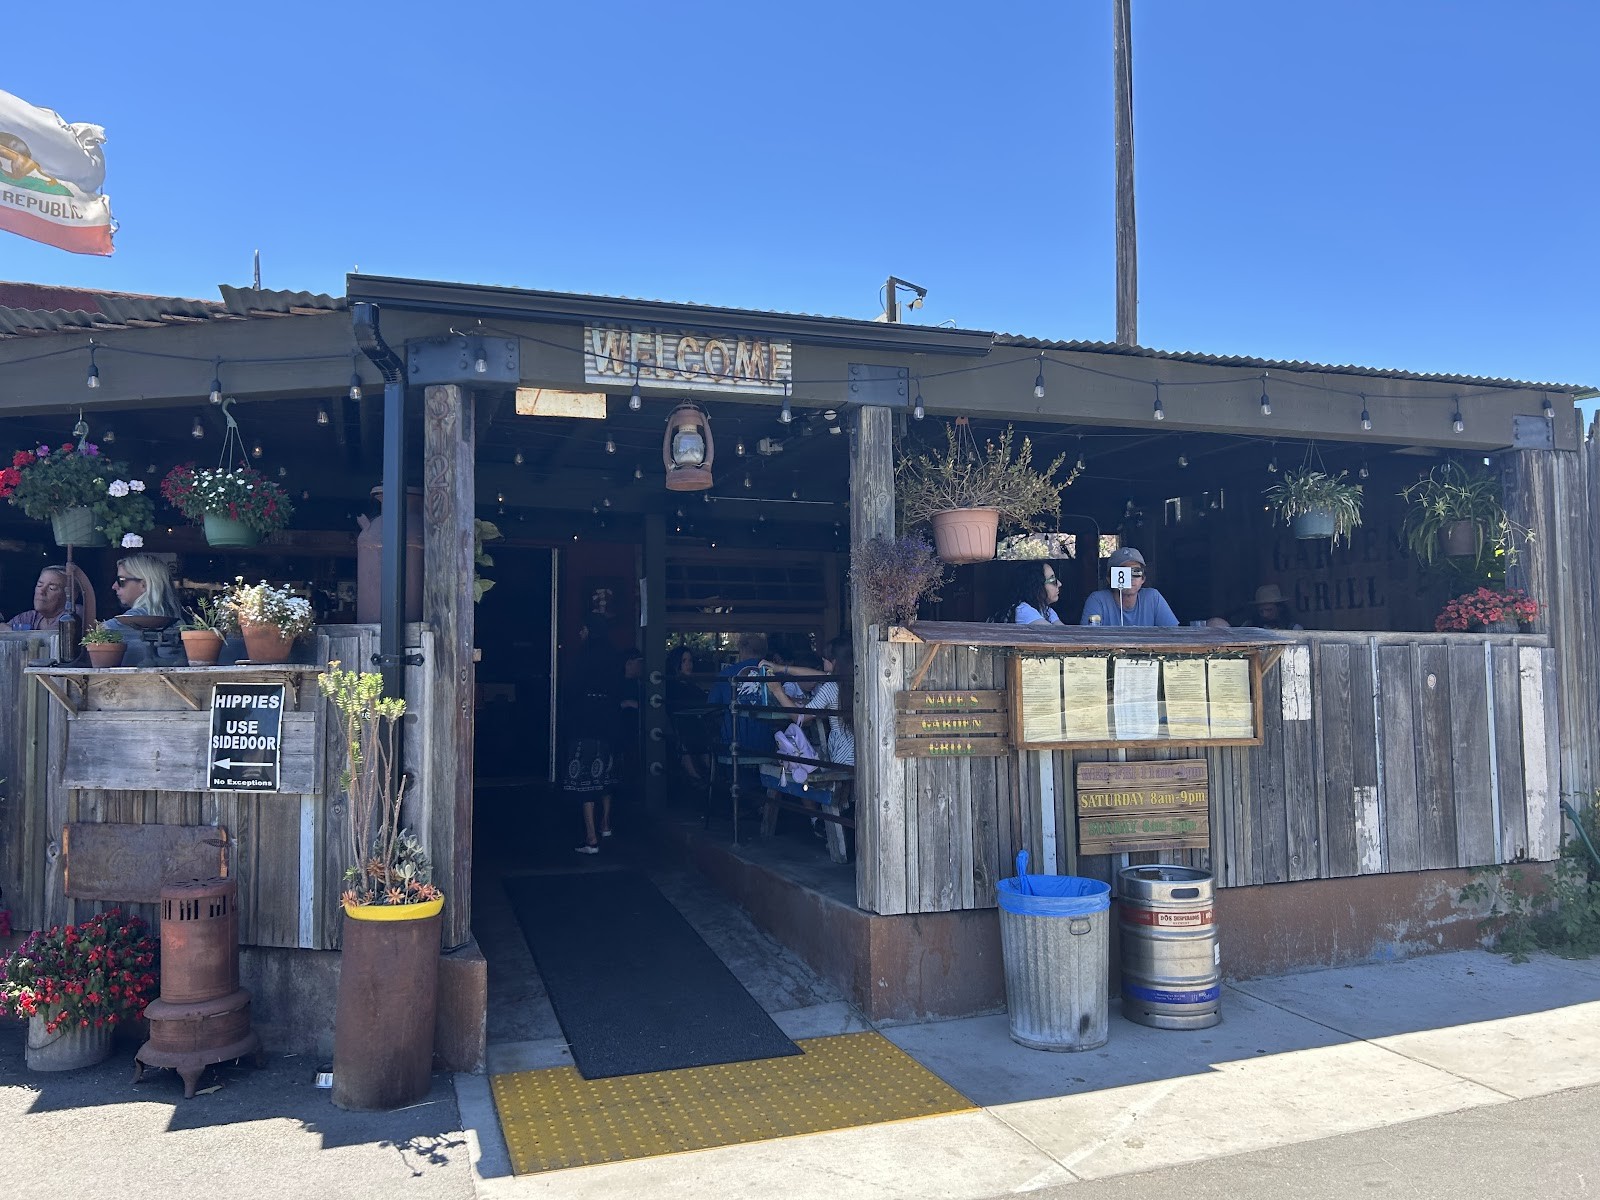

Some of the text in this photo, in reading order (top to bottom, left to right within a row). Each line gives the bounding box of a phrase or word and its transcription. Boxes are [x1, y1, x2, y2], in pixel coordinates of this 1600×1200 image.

[592, 328, 790, 384] WELCOME
[1117, 571, 1125, 584] 8
[1295, 576, 1385, 612] GRILL
[215, 694, 280, 709] HIPPIES
[925, 692, 979, 708] NATE'S
[226, 720, 259, 735] USE
[921, 715, 984, 732] GARDEN
[212, 735, 276, 750] SIDEDOOR
[929, 739, 976, 756] GRILL
[227, 778, 273, 787] Exceptions
[1081, 790, 1206, 808] SATURDAY 8am-9pm
[1088, 820, 1137, 836] SUNDAY
